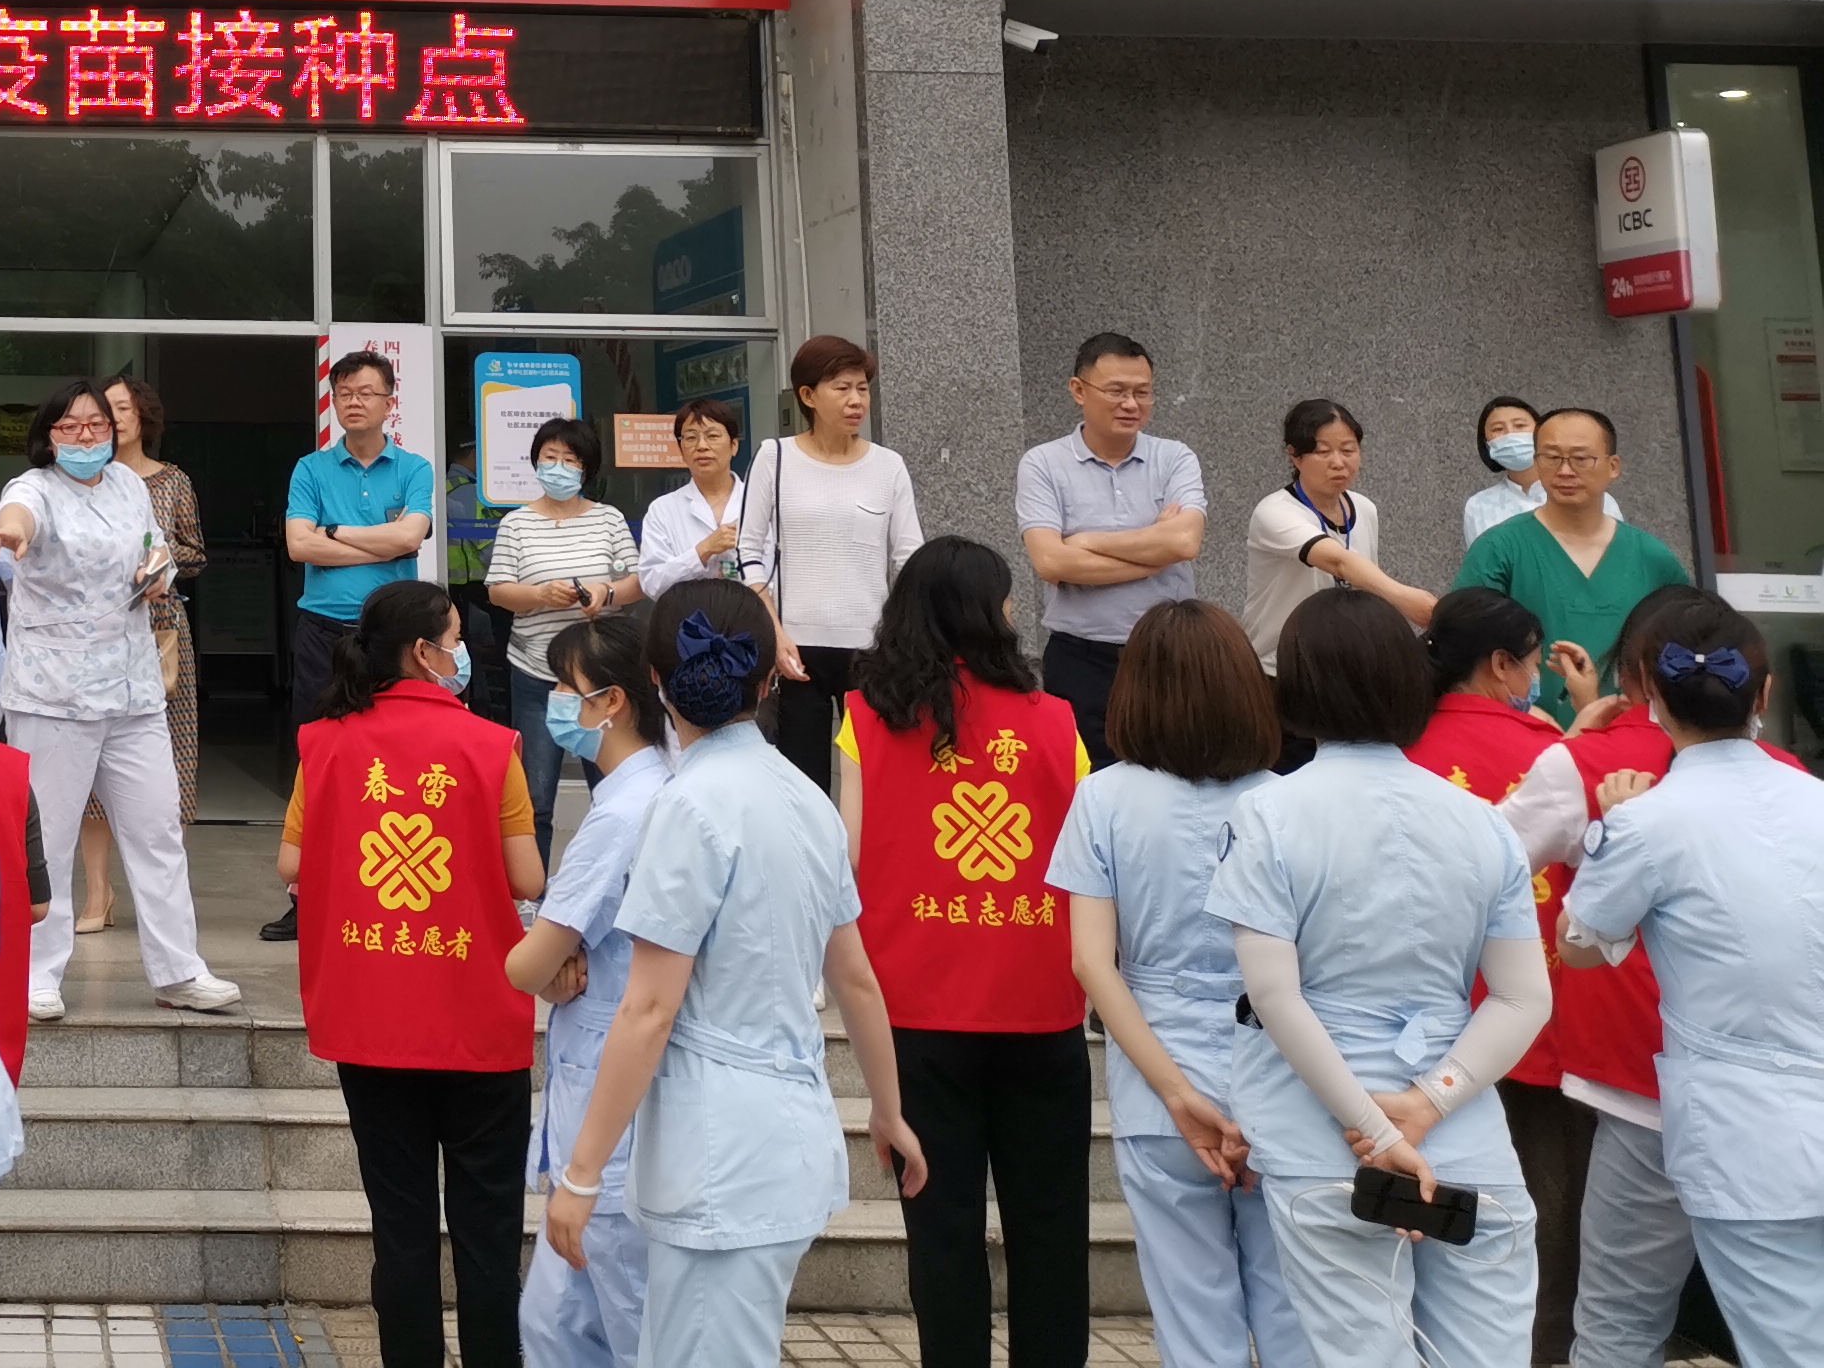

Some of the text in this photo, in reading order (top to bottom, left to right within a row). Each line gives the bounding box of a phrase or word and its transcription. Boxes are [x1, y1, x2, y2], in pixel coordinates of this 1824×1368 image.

[1617, 208, 1654, 234] ICBC
[1611, 277, 1634, 299] 24h
[360, 757, 458, 809] 春雷
[910, 891, 1057, 927] 社区志愿者
[340, 919, 473, 961] 社区志愿者
